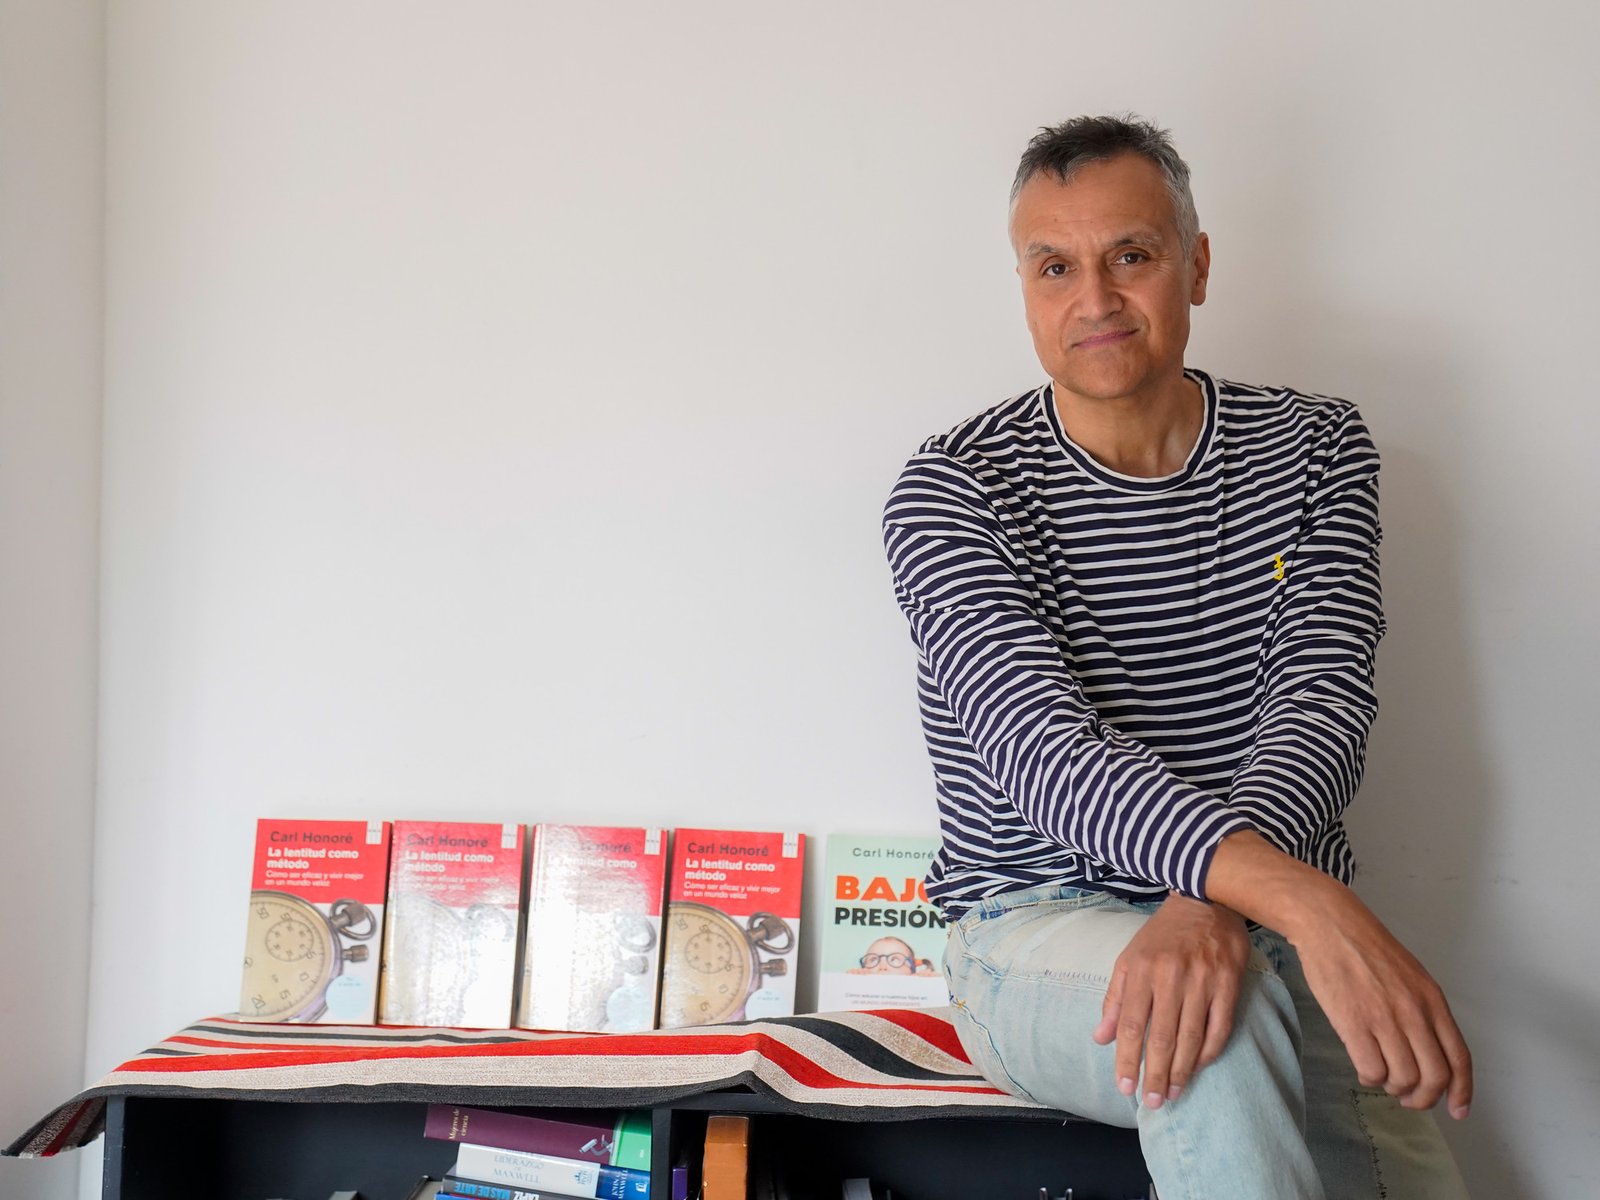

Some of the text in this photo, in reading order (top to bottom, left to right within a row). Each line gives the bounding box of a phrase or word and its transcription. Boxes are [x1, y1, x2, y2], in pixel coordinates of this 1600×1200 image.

[270, 831, 353, 844] Carl Honoré
[407, 833, 434, 845] Carl
[267, 847, 359, 859] La lentitud como
[687, 842, 769, 857] Carl Honoré
[852, 847, 934, 860] Carl Honoré
[405, 850, 494, 863] La lentitud como
[267, 858, 309, 869] método
[685, 858, 775, 872] La lentitud como
[685, 870, 726, 881] método
[704, 890, 728, 898] mundo
[834, 905, 946, 929] PRESIÓN
[448, 1116, 459, 1140] Mujeres
[461, 1115, 469, 1137] ciencia
[493, 1168, 541, 1183] MAXWELL
[453, 1181, 478, 1195] ARTE
[617, 1169, 629, 1199] MAXWELL
[477, 1185, 490, 1197] DE
